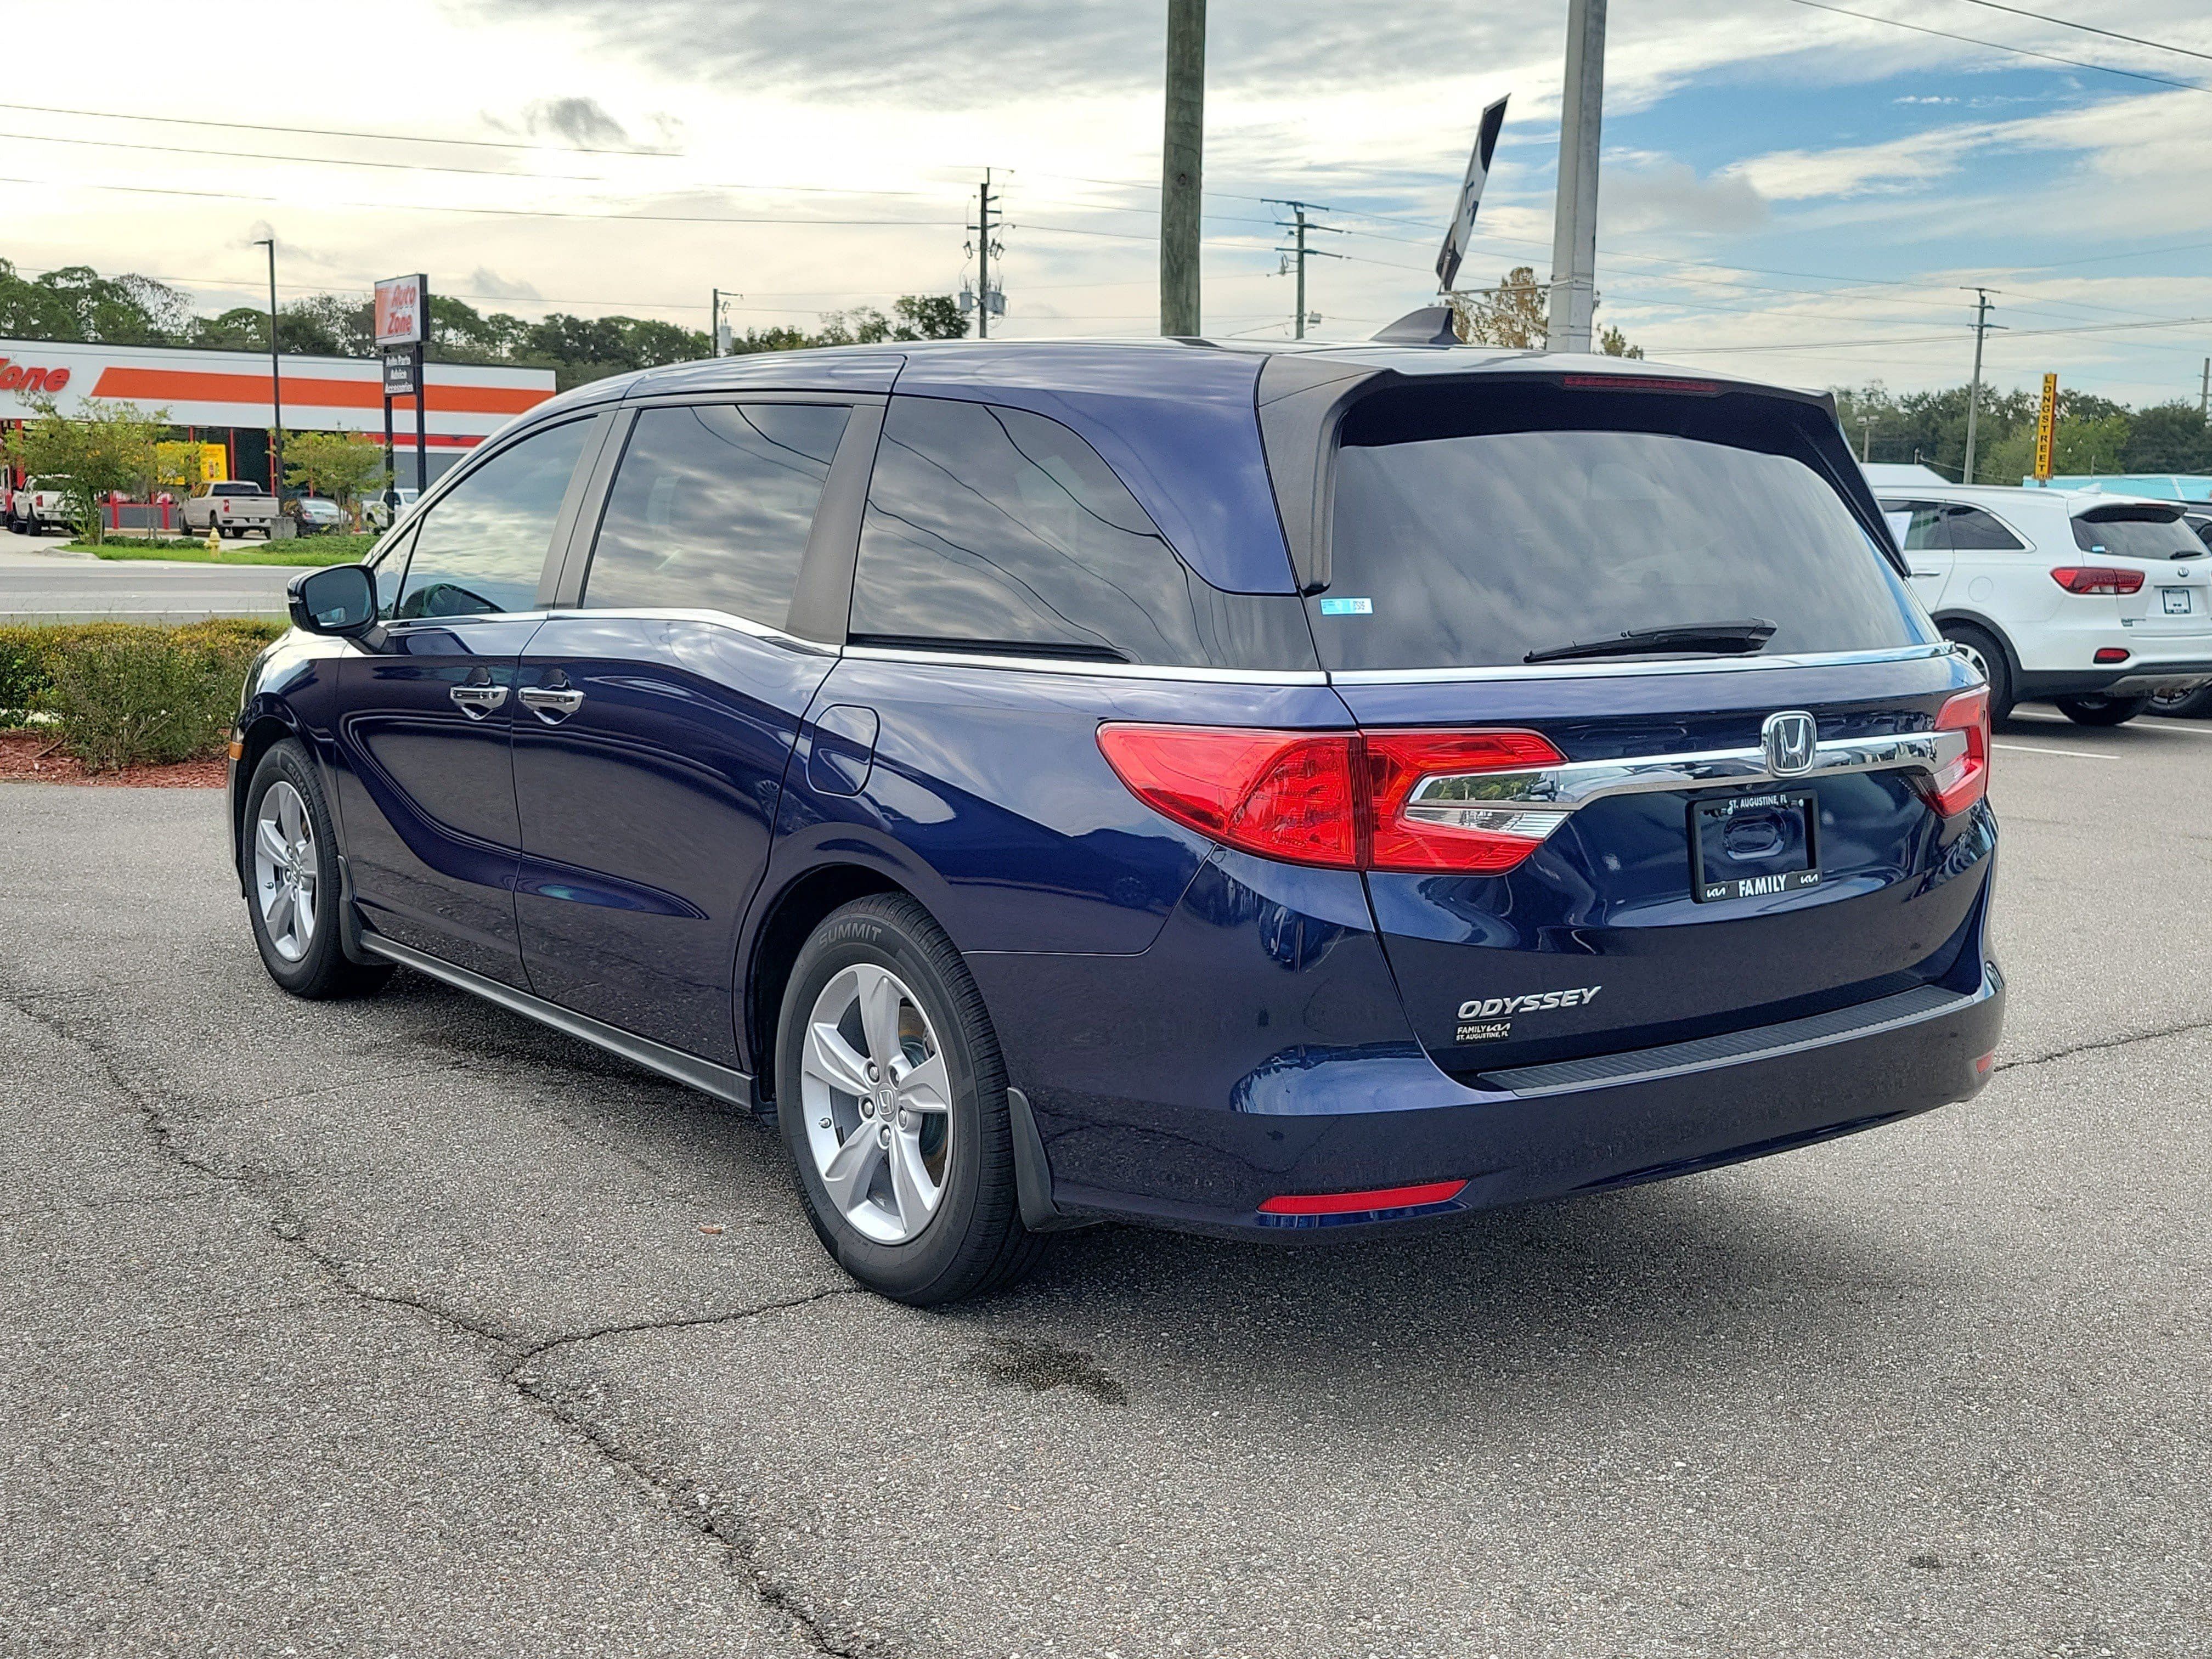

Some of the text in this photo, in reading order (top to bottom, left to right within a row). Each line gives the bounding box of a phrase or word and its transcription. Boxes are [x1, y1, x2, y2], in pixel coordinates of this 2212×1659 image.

[392, 284, 416, 308] Auto
[387, 312, 413, 335] Zone
[2039, 376, 2052, 472] LONGSTREET
[1729, 794, 1787, 809] ST. AUGUSTINE, FL
[1738, 874, 1787, 898] FAMILY
[819, 922, 882, 948] SUMMIT
[1457, 985, 1602, 1019] ODYSSEY
[1457, 1025, 1486, 1035] FAMILY
[1466, 1031, 1500, 1040] AUGUSTINE,
